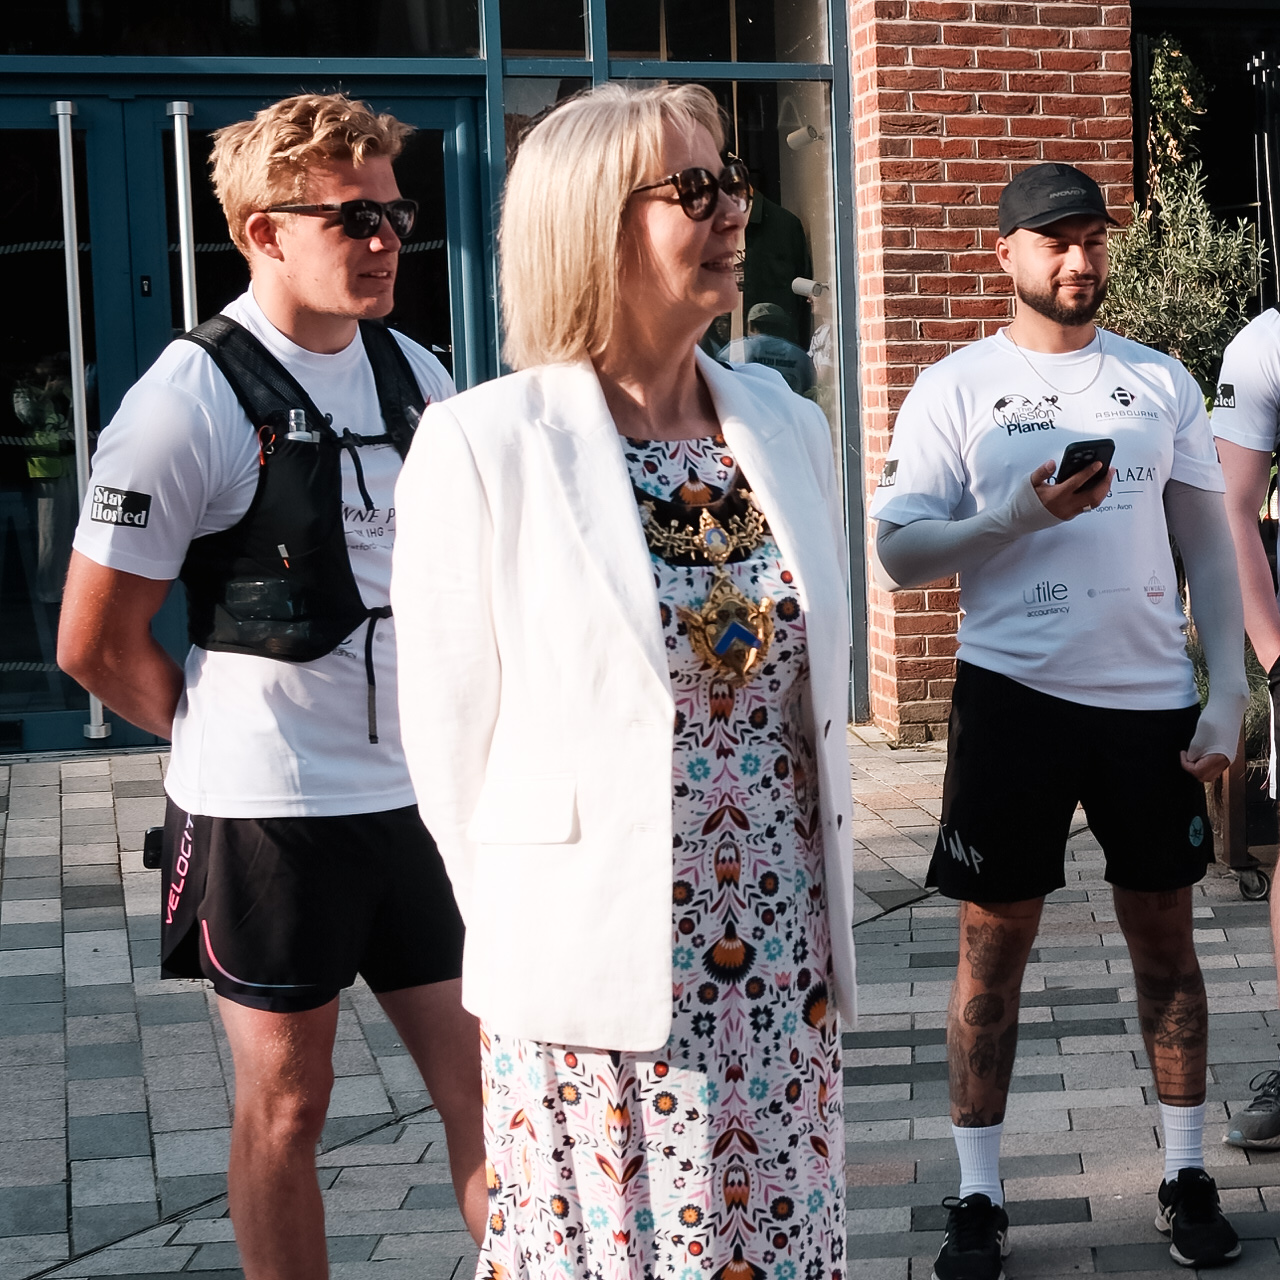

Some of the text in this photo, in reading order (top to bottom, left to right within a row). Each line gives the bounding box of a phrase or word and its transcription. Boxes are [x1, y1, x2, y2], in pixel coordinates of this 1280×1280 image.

[1002, 408, 1056, 426] Mission
[1095, 410, 1159, 419] ASHBOURNE
[1007, 419, 1056, 436] Planet
[94, 486, 127, 507] Stay
[92, 503, 147, 525] Hosted
[1023, 581, 1068, 604] utile
[1026, 606, 1070, 618] accountancy
